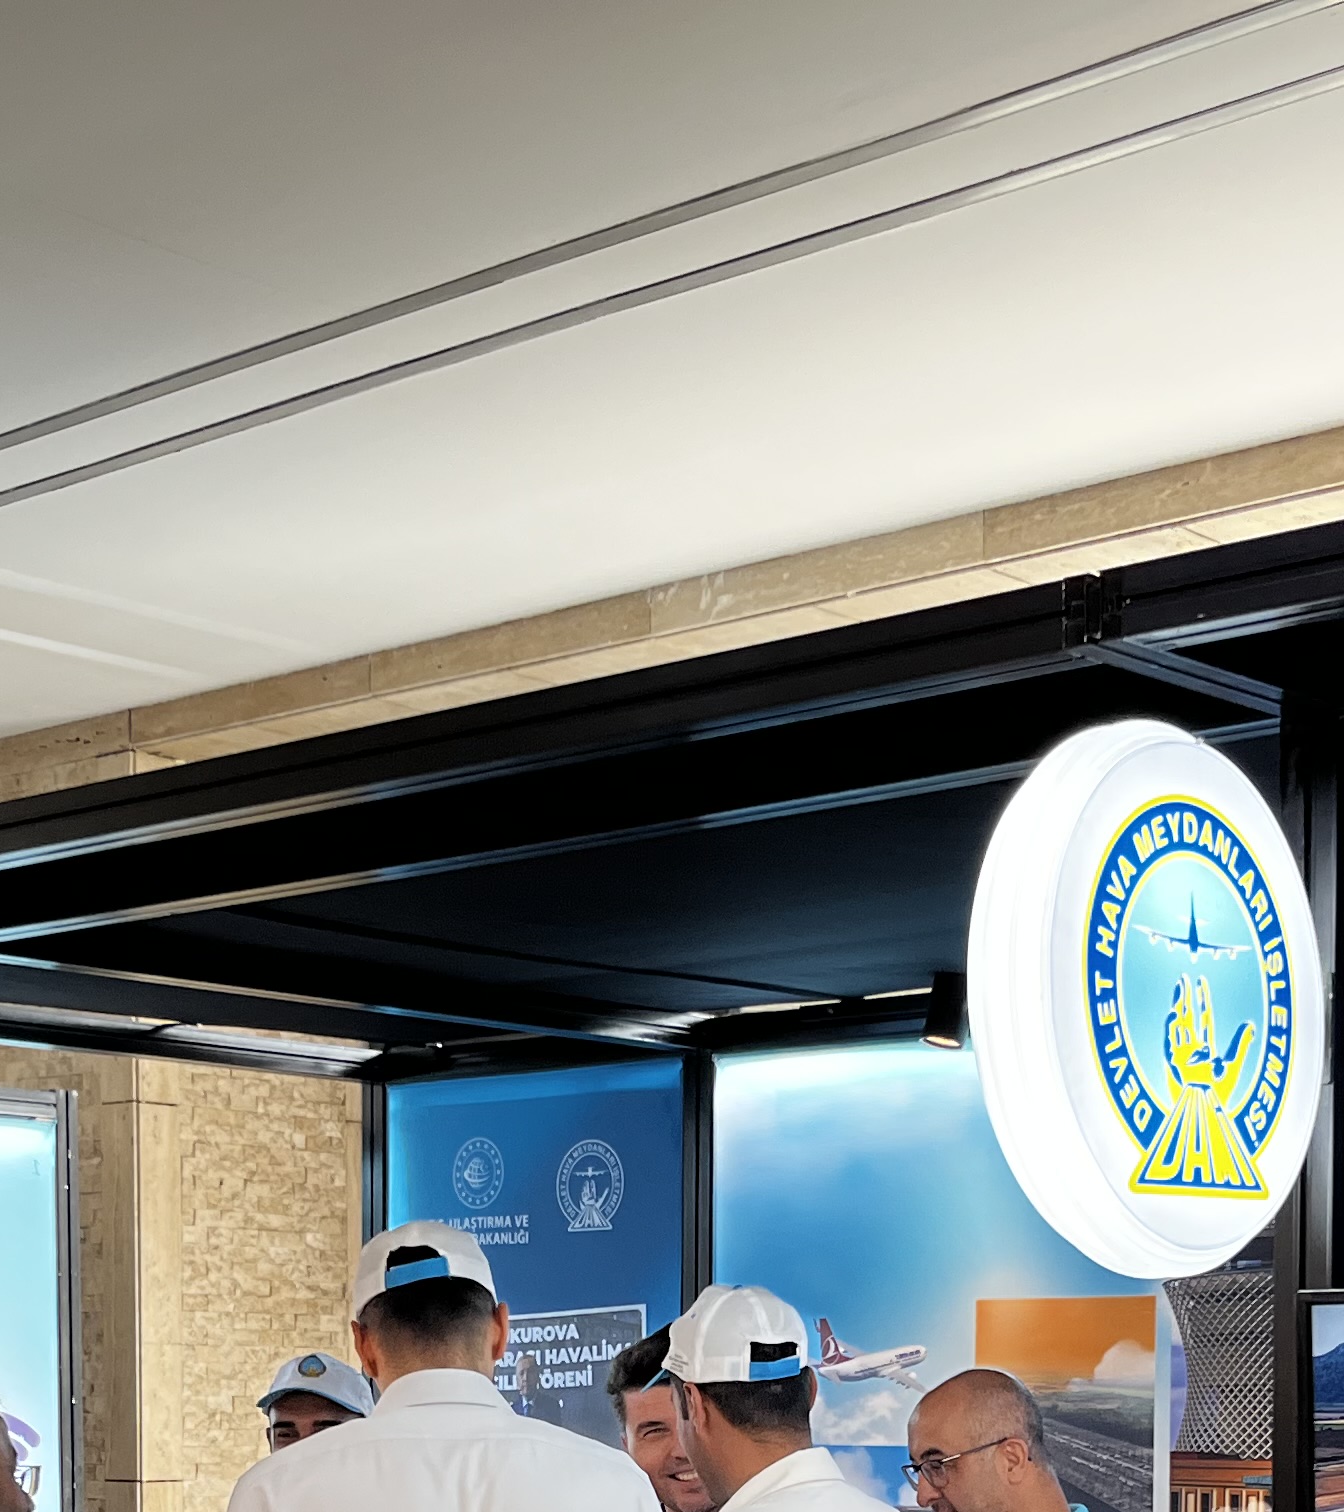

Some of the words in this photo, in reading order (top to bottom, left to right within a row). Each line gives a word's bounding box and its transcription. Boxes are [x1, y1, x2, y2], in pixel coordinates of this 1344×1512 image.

[1095, 854, 1138, 960] HAVA
[1131, 811, 1274, 933] MEYDANLARI
[1094, 971, 1153, 1133] DEVLET
[1242, 935, 1288, 1149] İŞLETMESİ
[514, 1215, 530, 1229] VE
[537, 1363, 594, 1390] ÖRENİ
